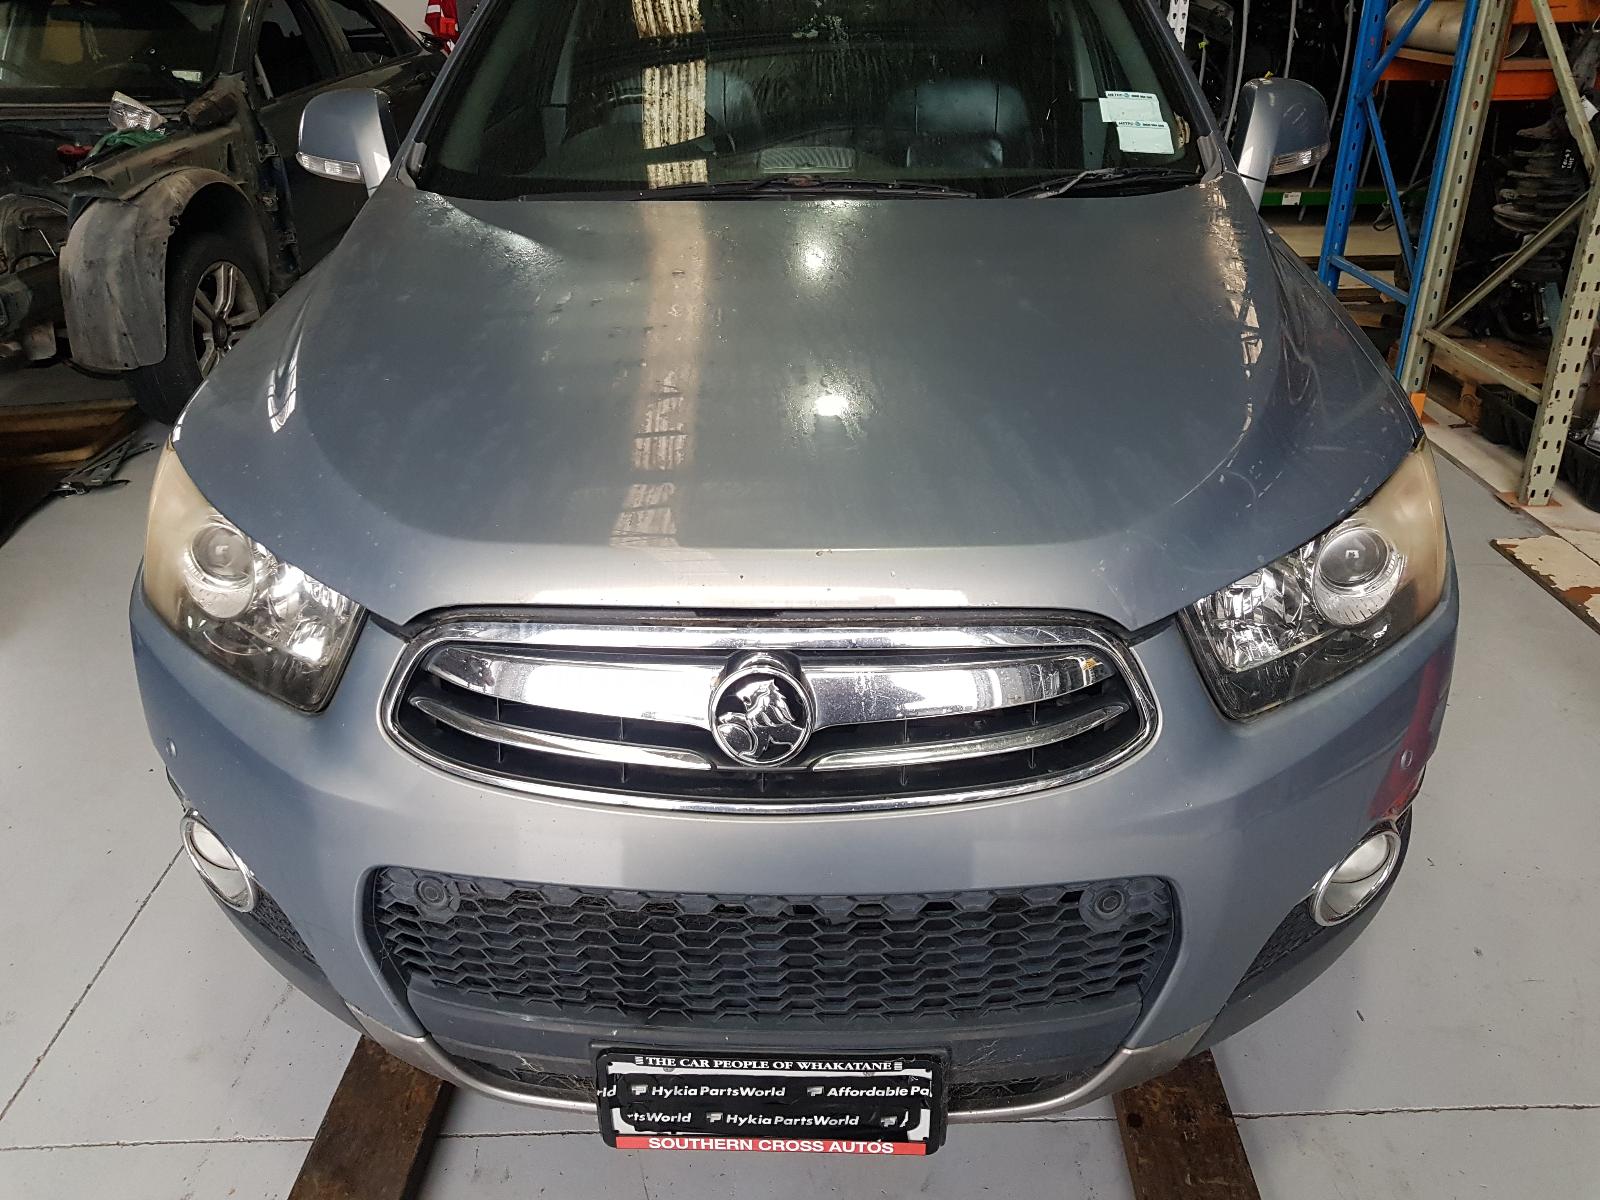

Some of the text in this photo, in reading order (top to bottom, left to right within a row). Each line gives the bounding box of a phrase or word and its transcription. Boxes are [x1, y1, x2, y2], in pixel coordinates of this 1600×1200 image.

[646, 1056, 892, 1071] THE CAR PEOPLE OF WHAKATANE
[652, 1085, 786, 1099] Hykia PartsWorld
[827, 1086, 909, 1097] Affordable
[726, 1114, 860, 1126] Hykia PartsWorld
[649, 1137, 894, 1154] SOUTHERN CROSS AUTOS
